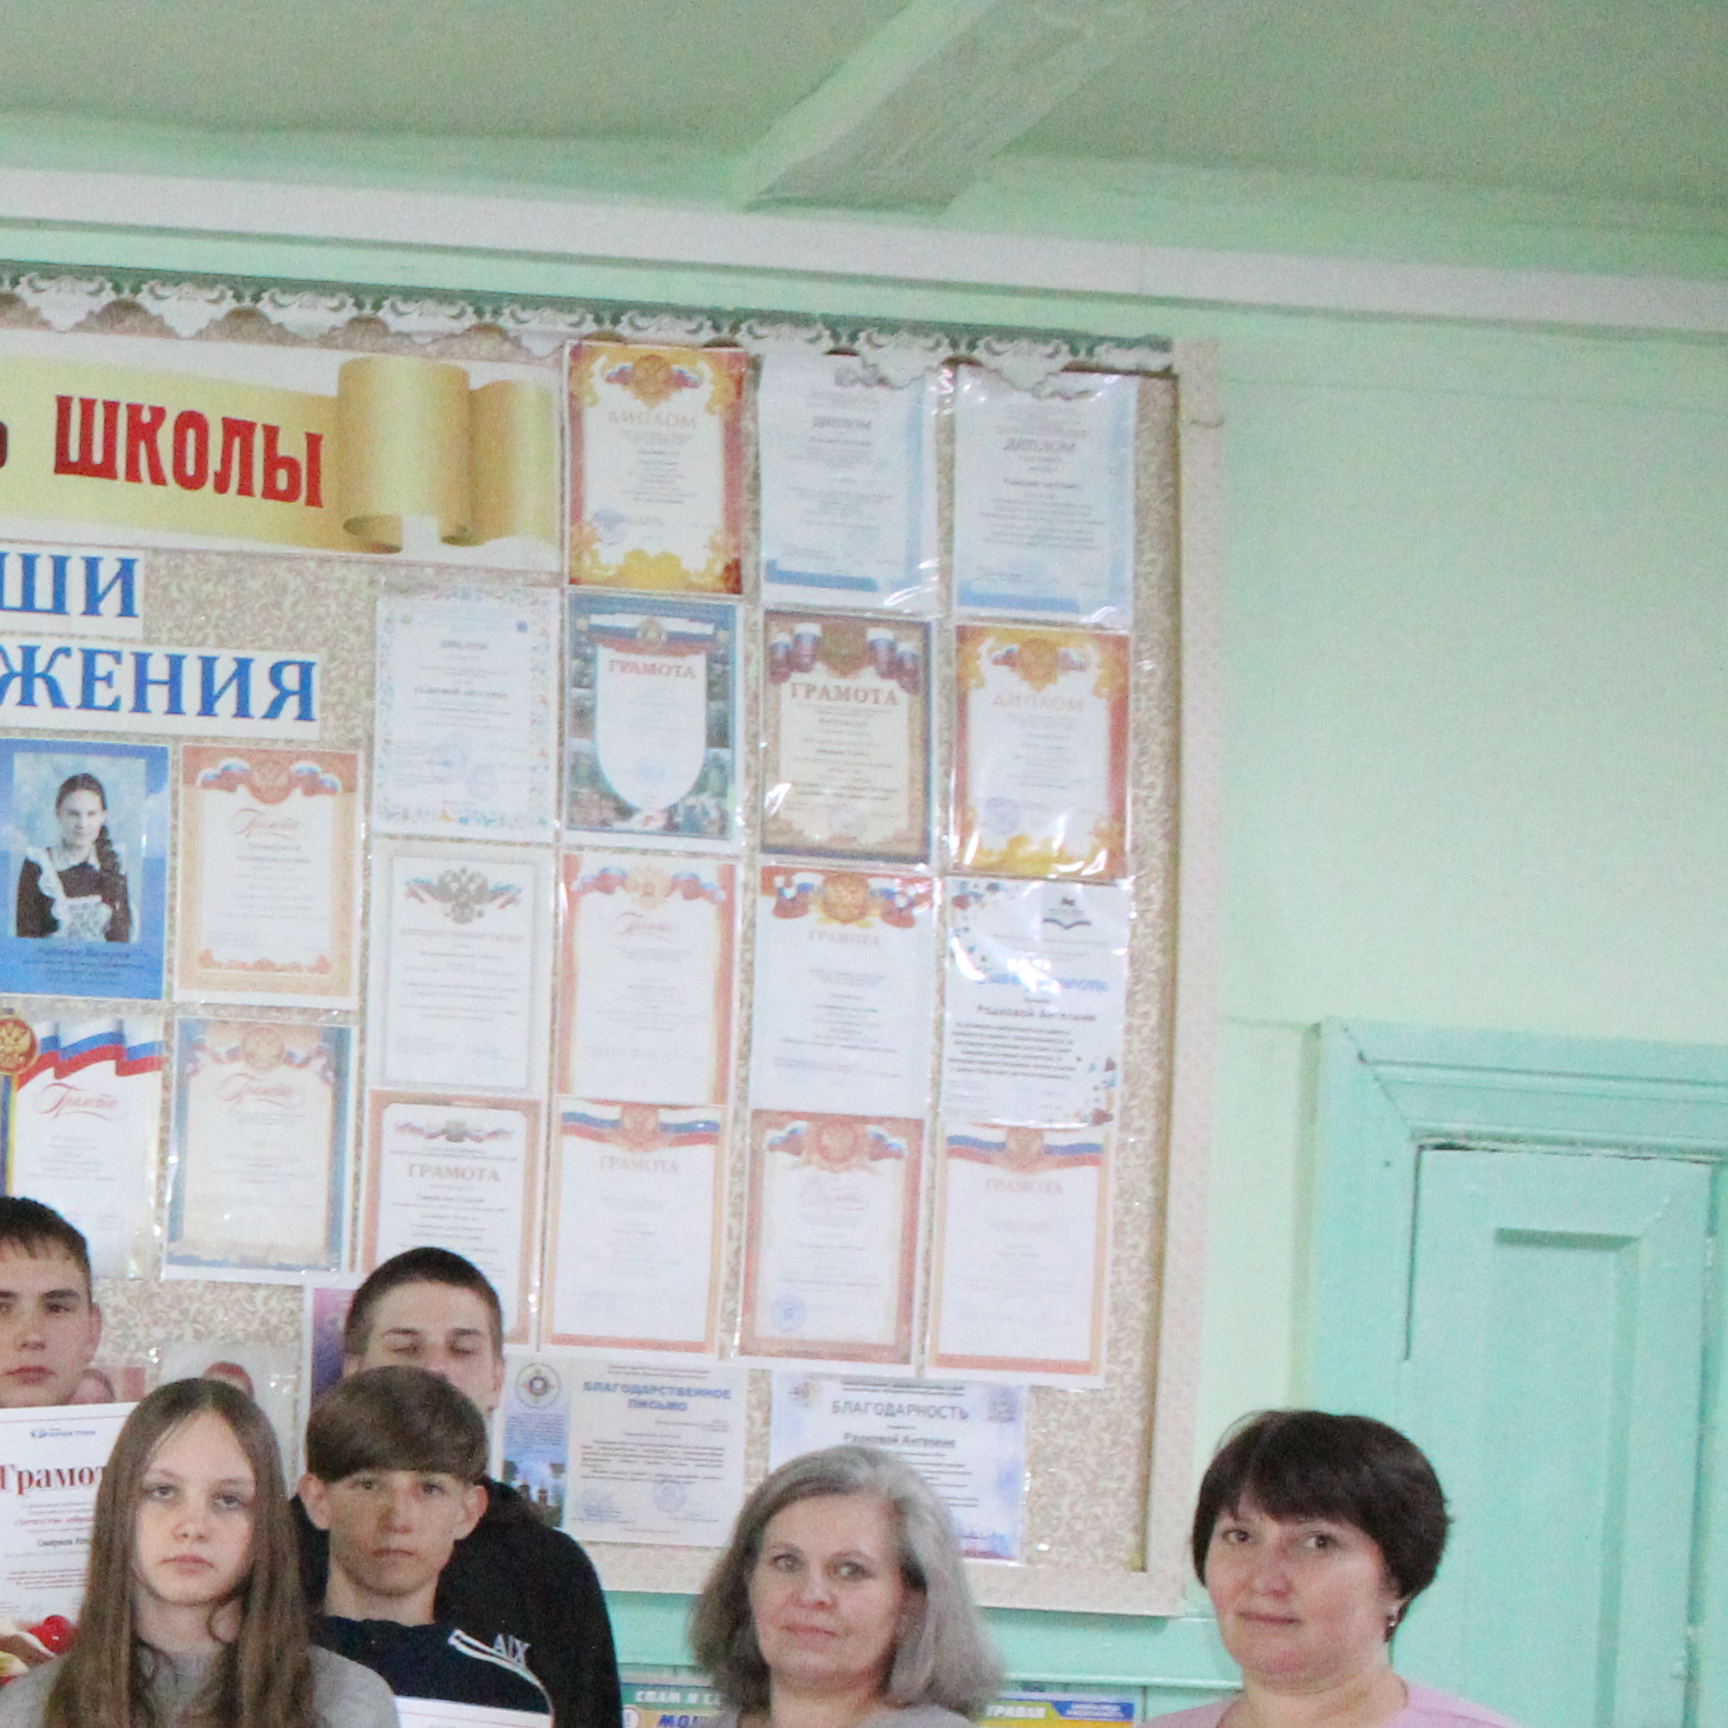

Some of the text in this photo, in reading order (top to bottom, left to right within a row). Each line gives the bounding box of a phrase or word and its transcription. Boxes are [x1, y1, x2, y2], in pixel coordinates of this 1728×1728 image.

[54, 395, 325, 508] ШКОЛЫ
[609, 659, 696, 678] ГРАМОТА
[791, 682, 899, 706] ГРАМОТА
[408, 1163, 501, 1183] ГРАМОТА
[583, 1380, 733, 1401] БЛАГОДАРСТВЕННОЕ
[627, 1399, 689, 1413] ПИСЬМО
[831, 1400, 970, 1422] БЛАГОДАРНОСТЬ
